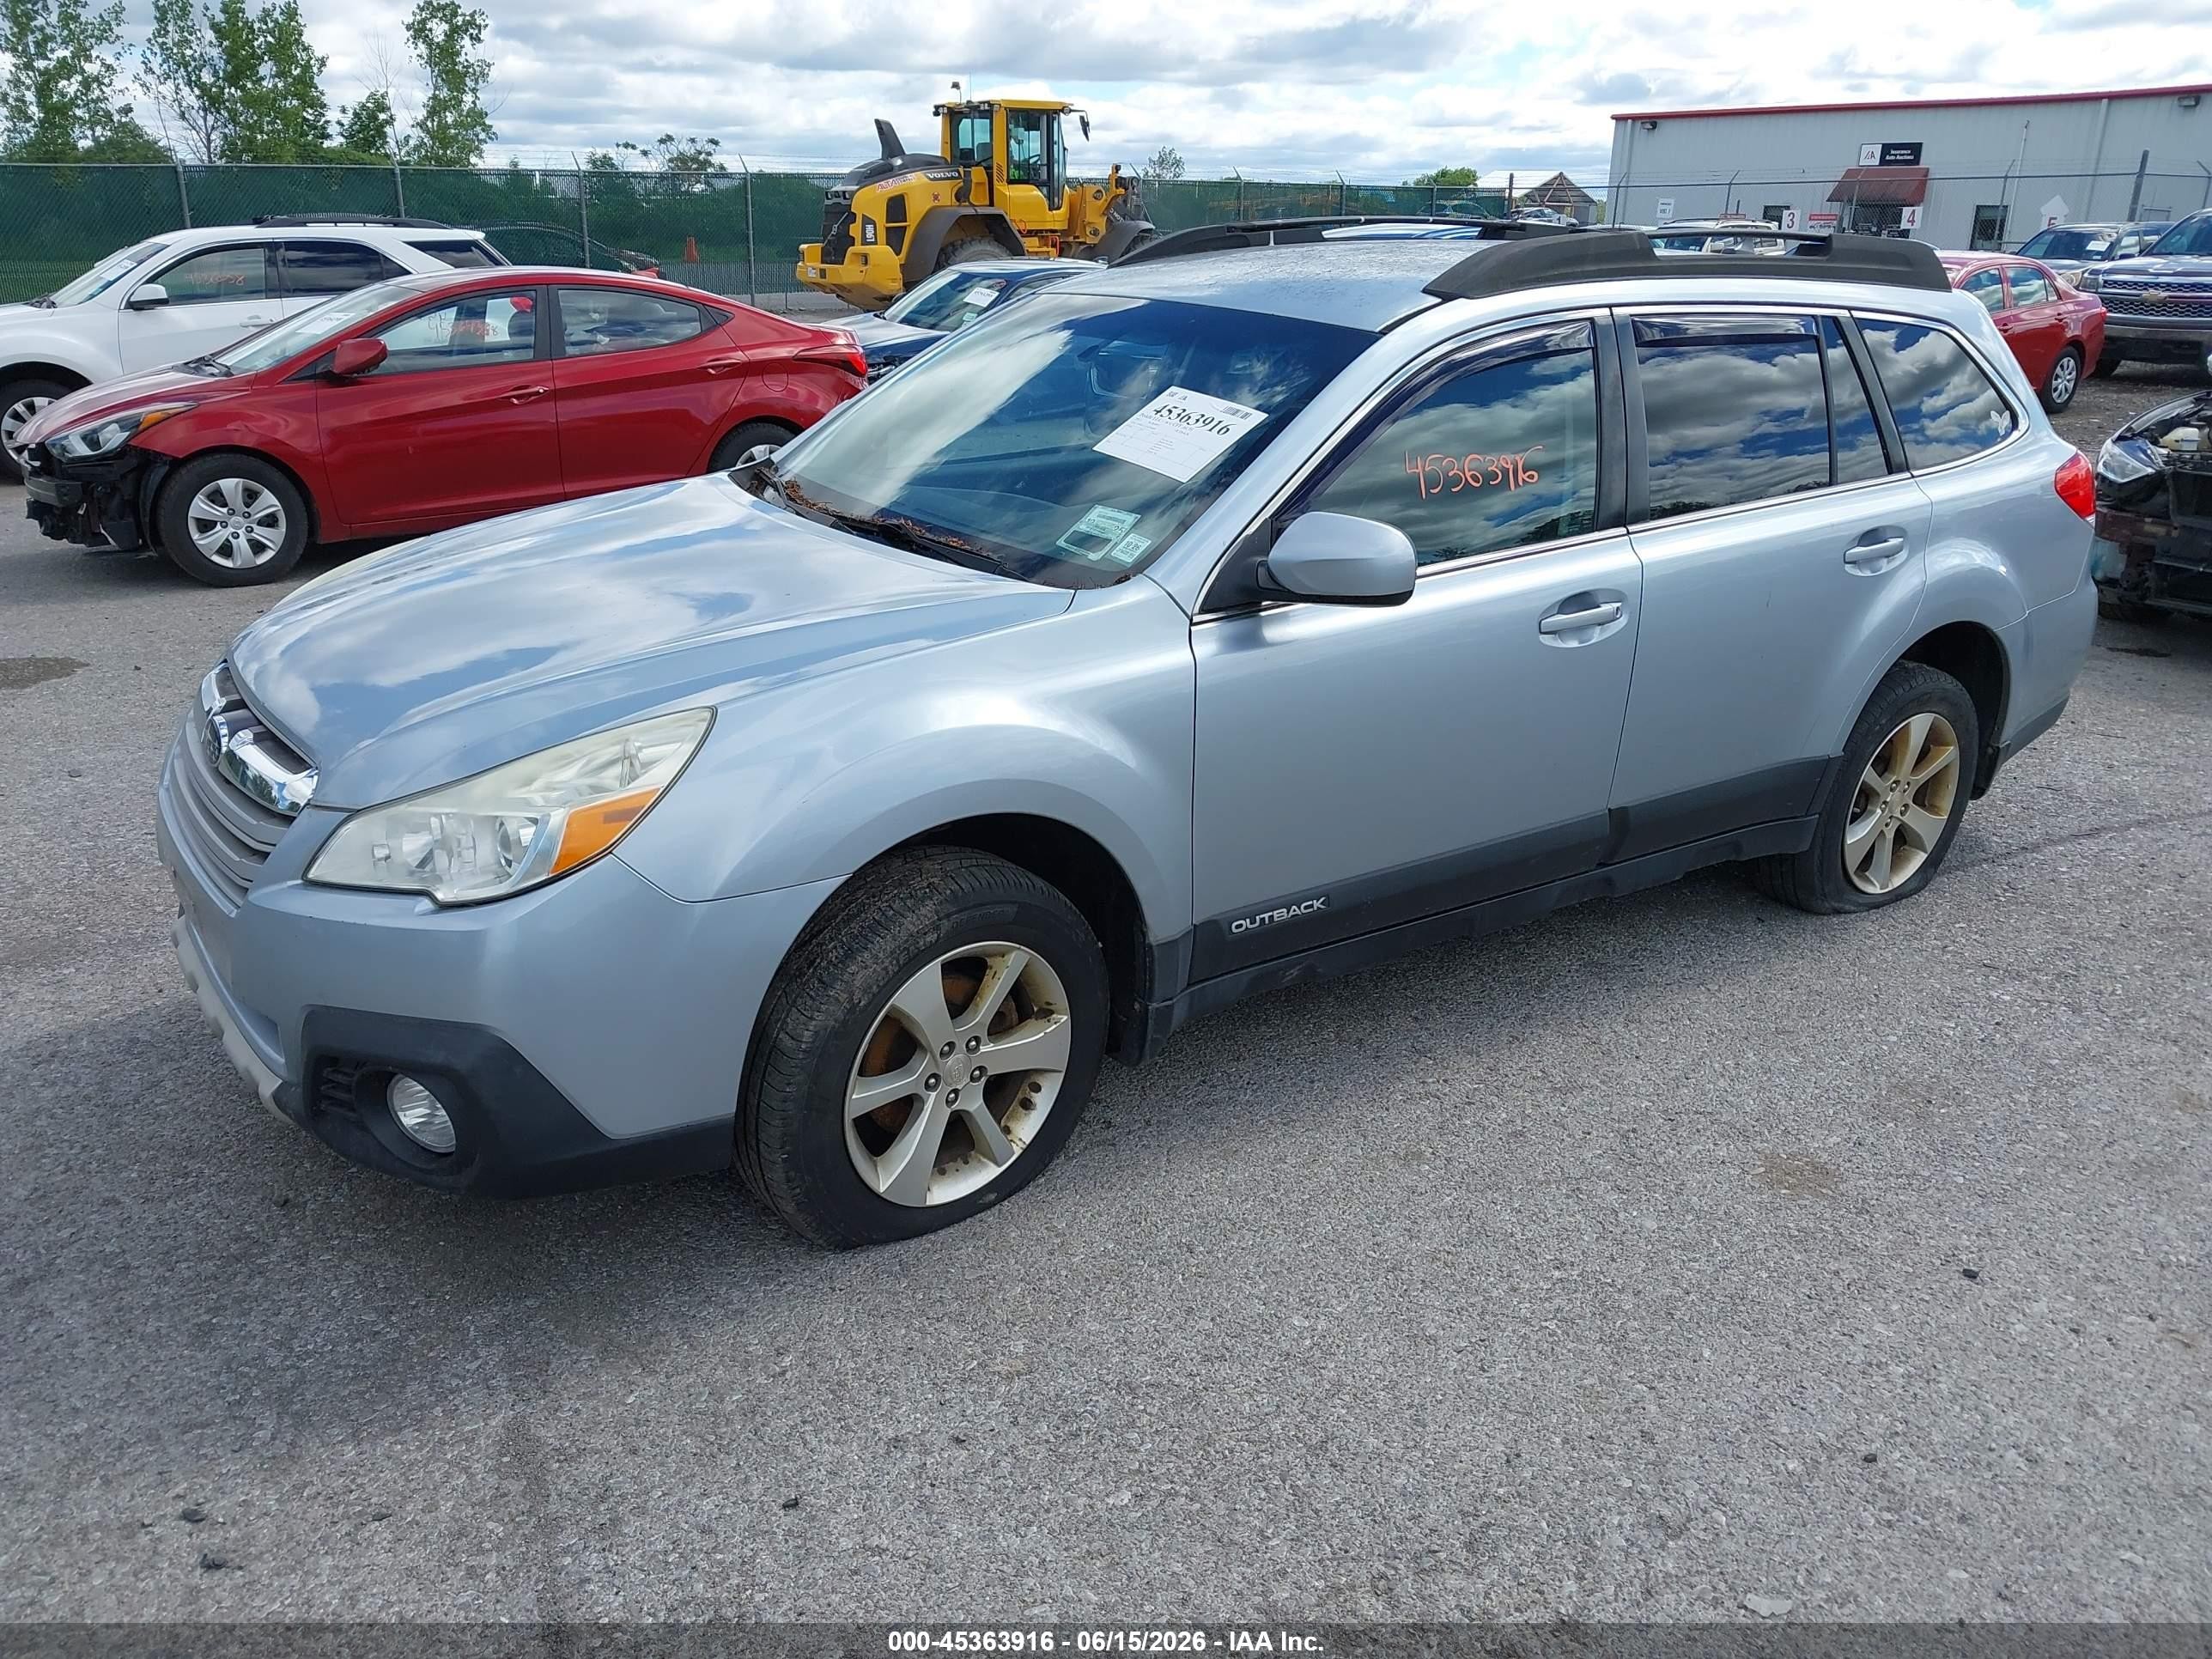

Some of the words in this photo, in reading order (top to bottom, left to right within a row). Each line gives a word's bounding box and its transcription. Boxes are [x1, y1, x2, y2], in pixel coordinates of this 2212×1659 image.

[926, 171, 959, 179] VOLVO
[1787, 212, 1796, 229] 3
[1907, 209, 1917, 228] 4
[866, 224, 875, 242] L90H
[1152, 404, 1237, 436] 45363916
[1231, 896, 1328, 933] OUTBACK
